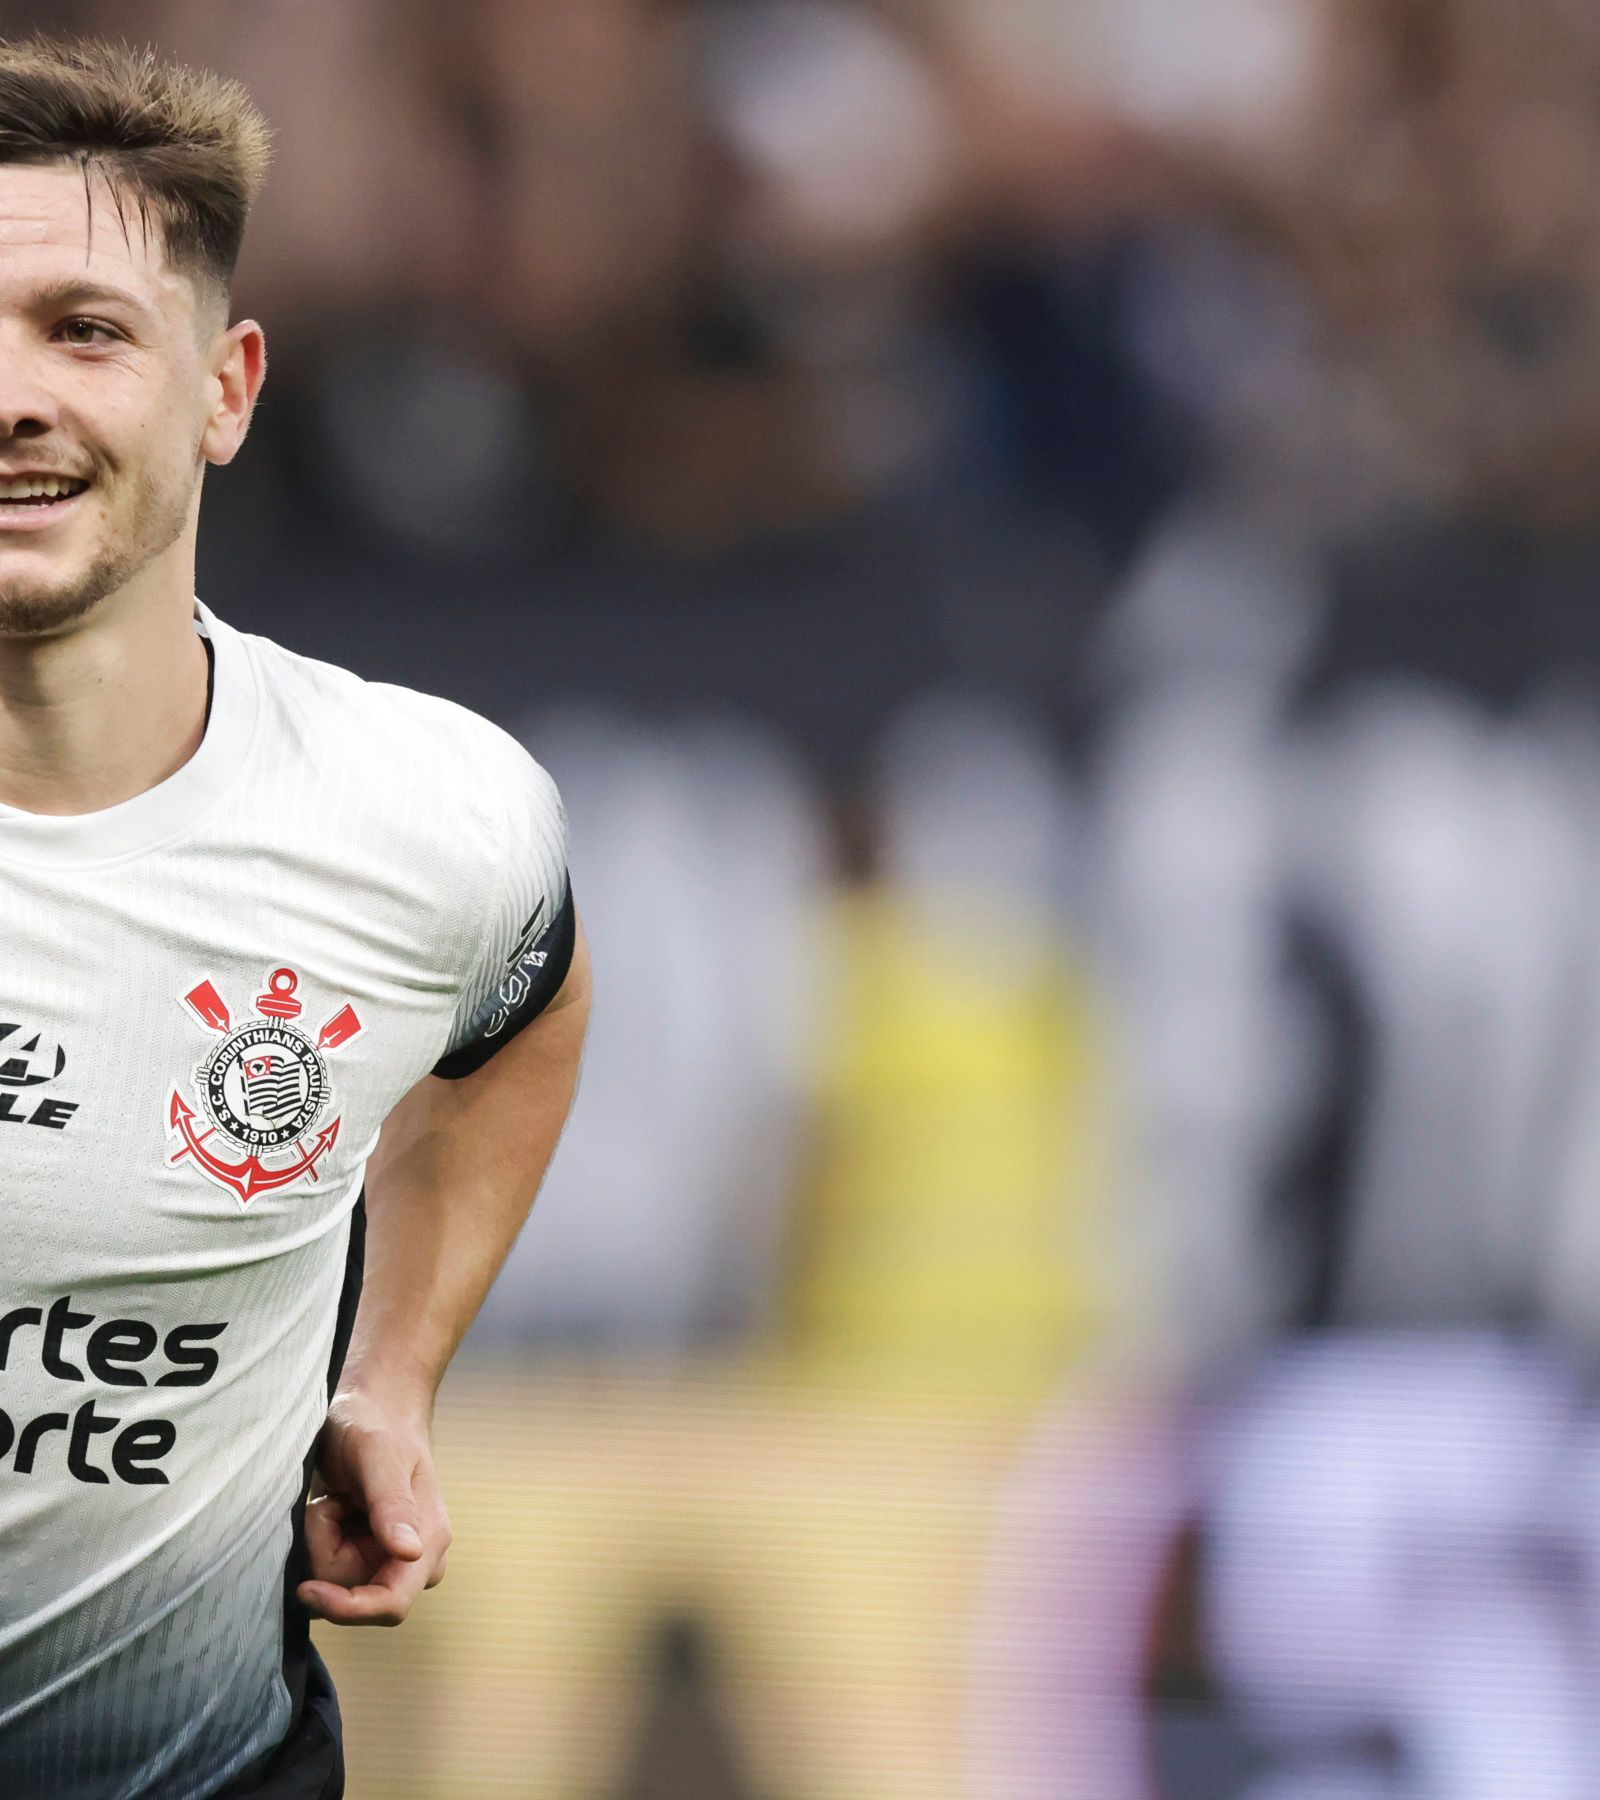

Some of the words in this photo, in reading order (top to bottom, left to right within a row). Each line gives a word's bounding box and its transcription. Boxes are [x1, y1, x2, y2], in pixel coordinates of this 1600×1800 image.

[210, 1029, 305, 1086] CORINTHIANS
[290, 1052, 322, 1129] PAULISTA
[241, 1128, 279, 1144] 1910
